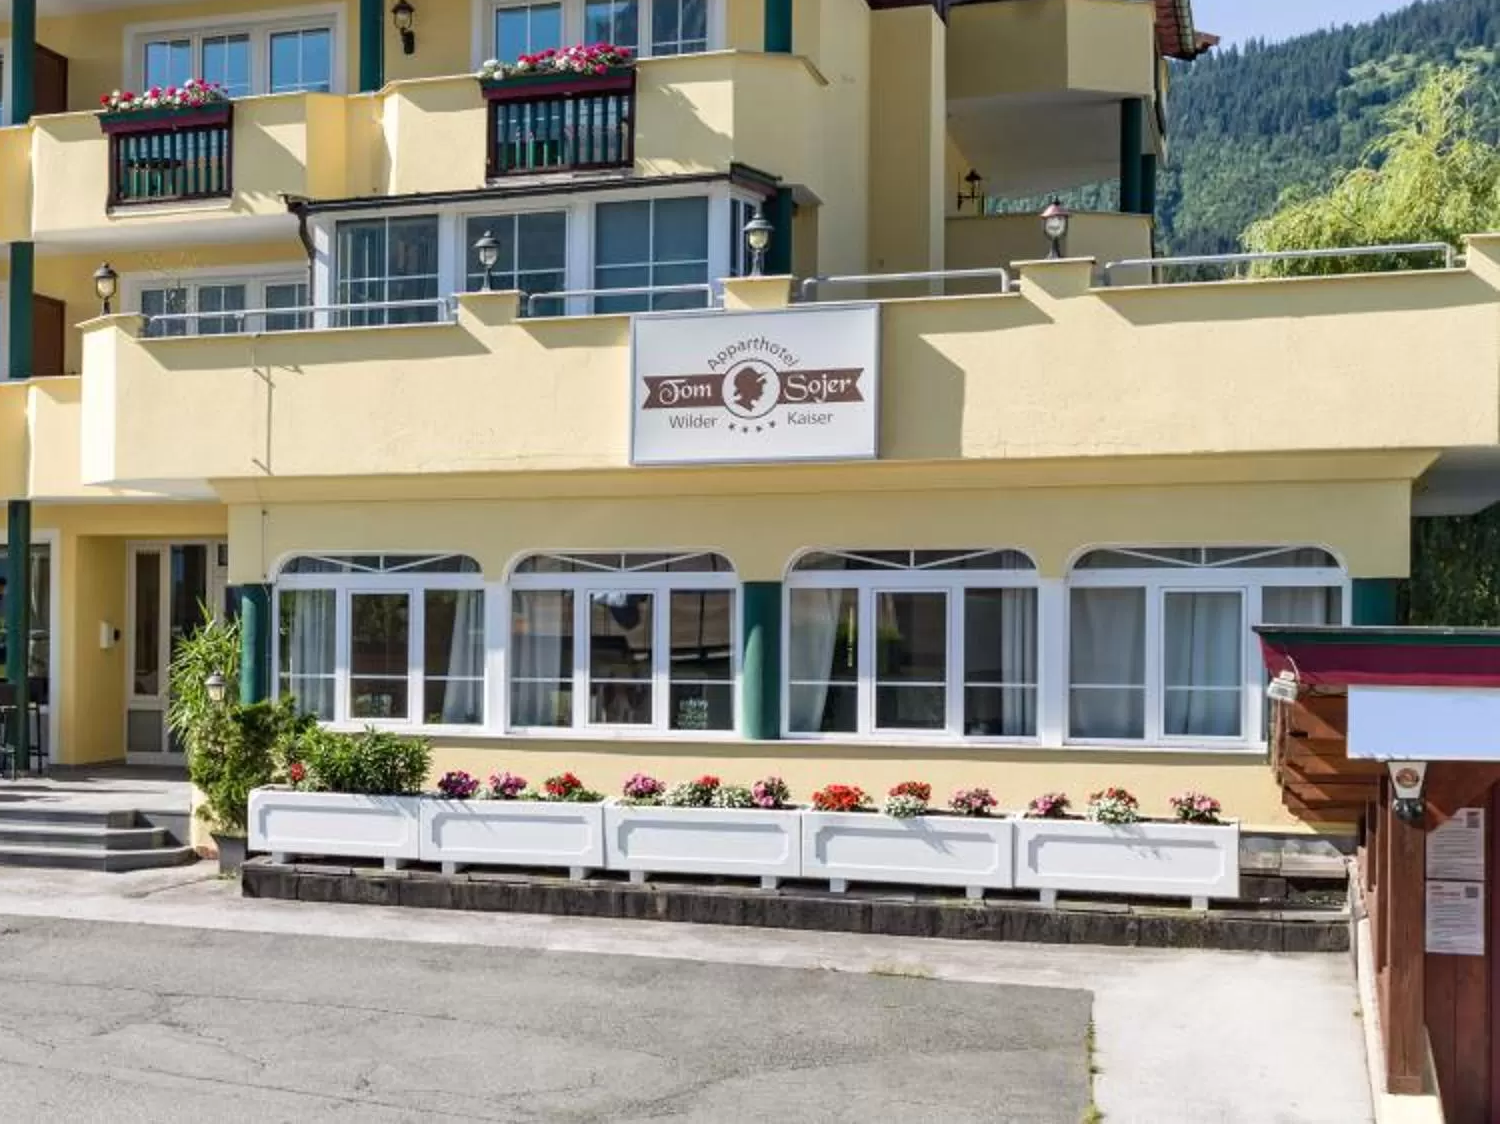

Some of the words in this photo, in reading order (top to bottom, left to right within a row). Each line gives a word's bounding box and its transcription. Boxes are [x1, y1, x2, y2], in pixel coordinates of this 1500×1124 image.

[707, 336, 799, 372] Apparthotel
[658, 378, 712, 405] Tom
[783, 373, 852, 404] Sojer
[669, 415, 719, 429] Wilder
[787, 410, 835, 425] Kaiser
